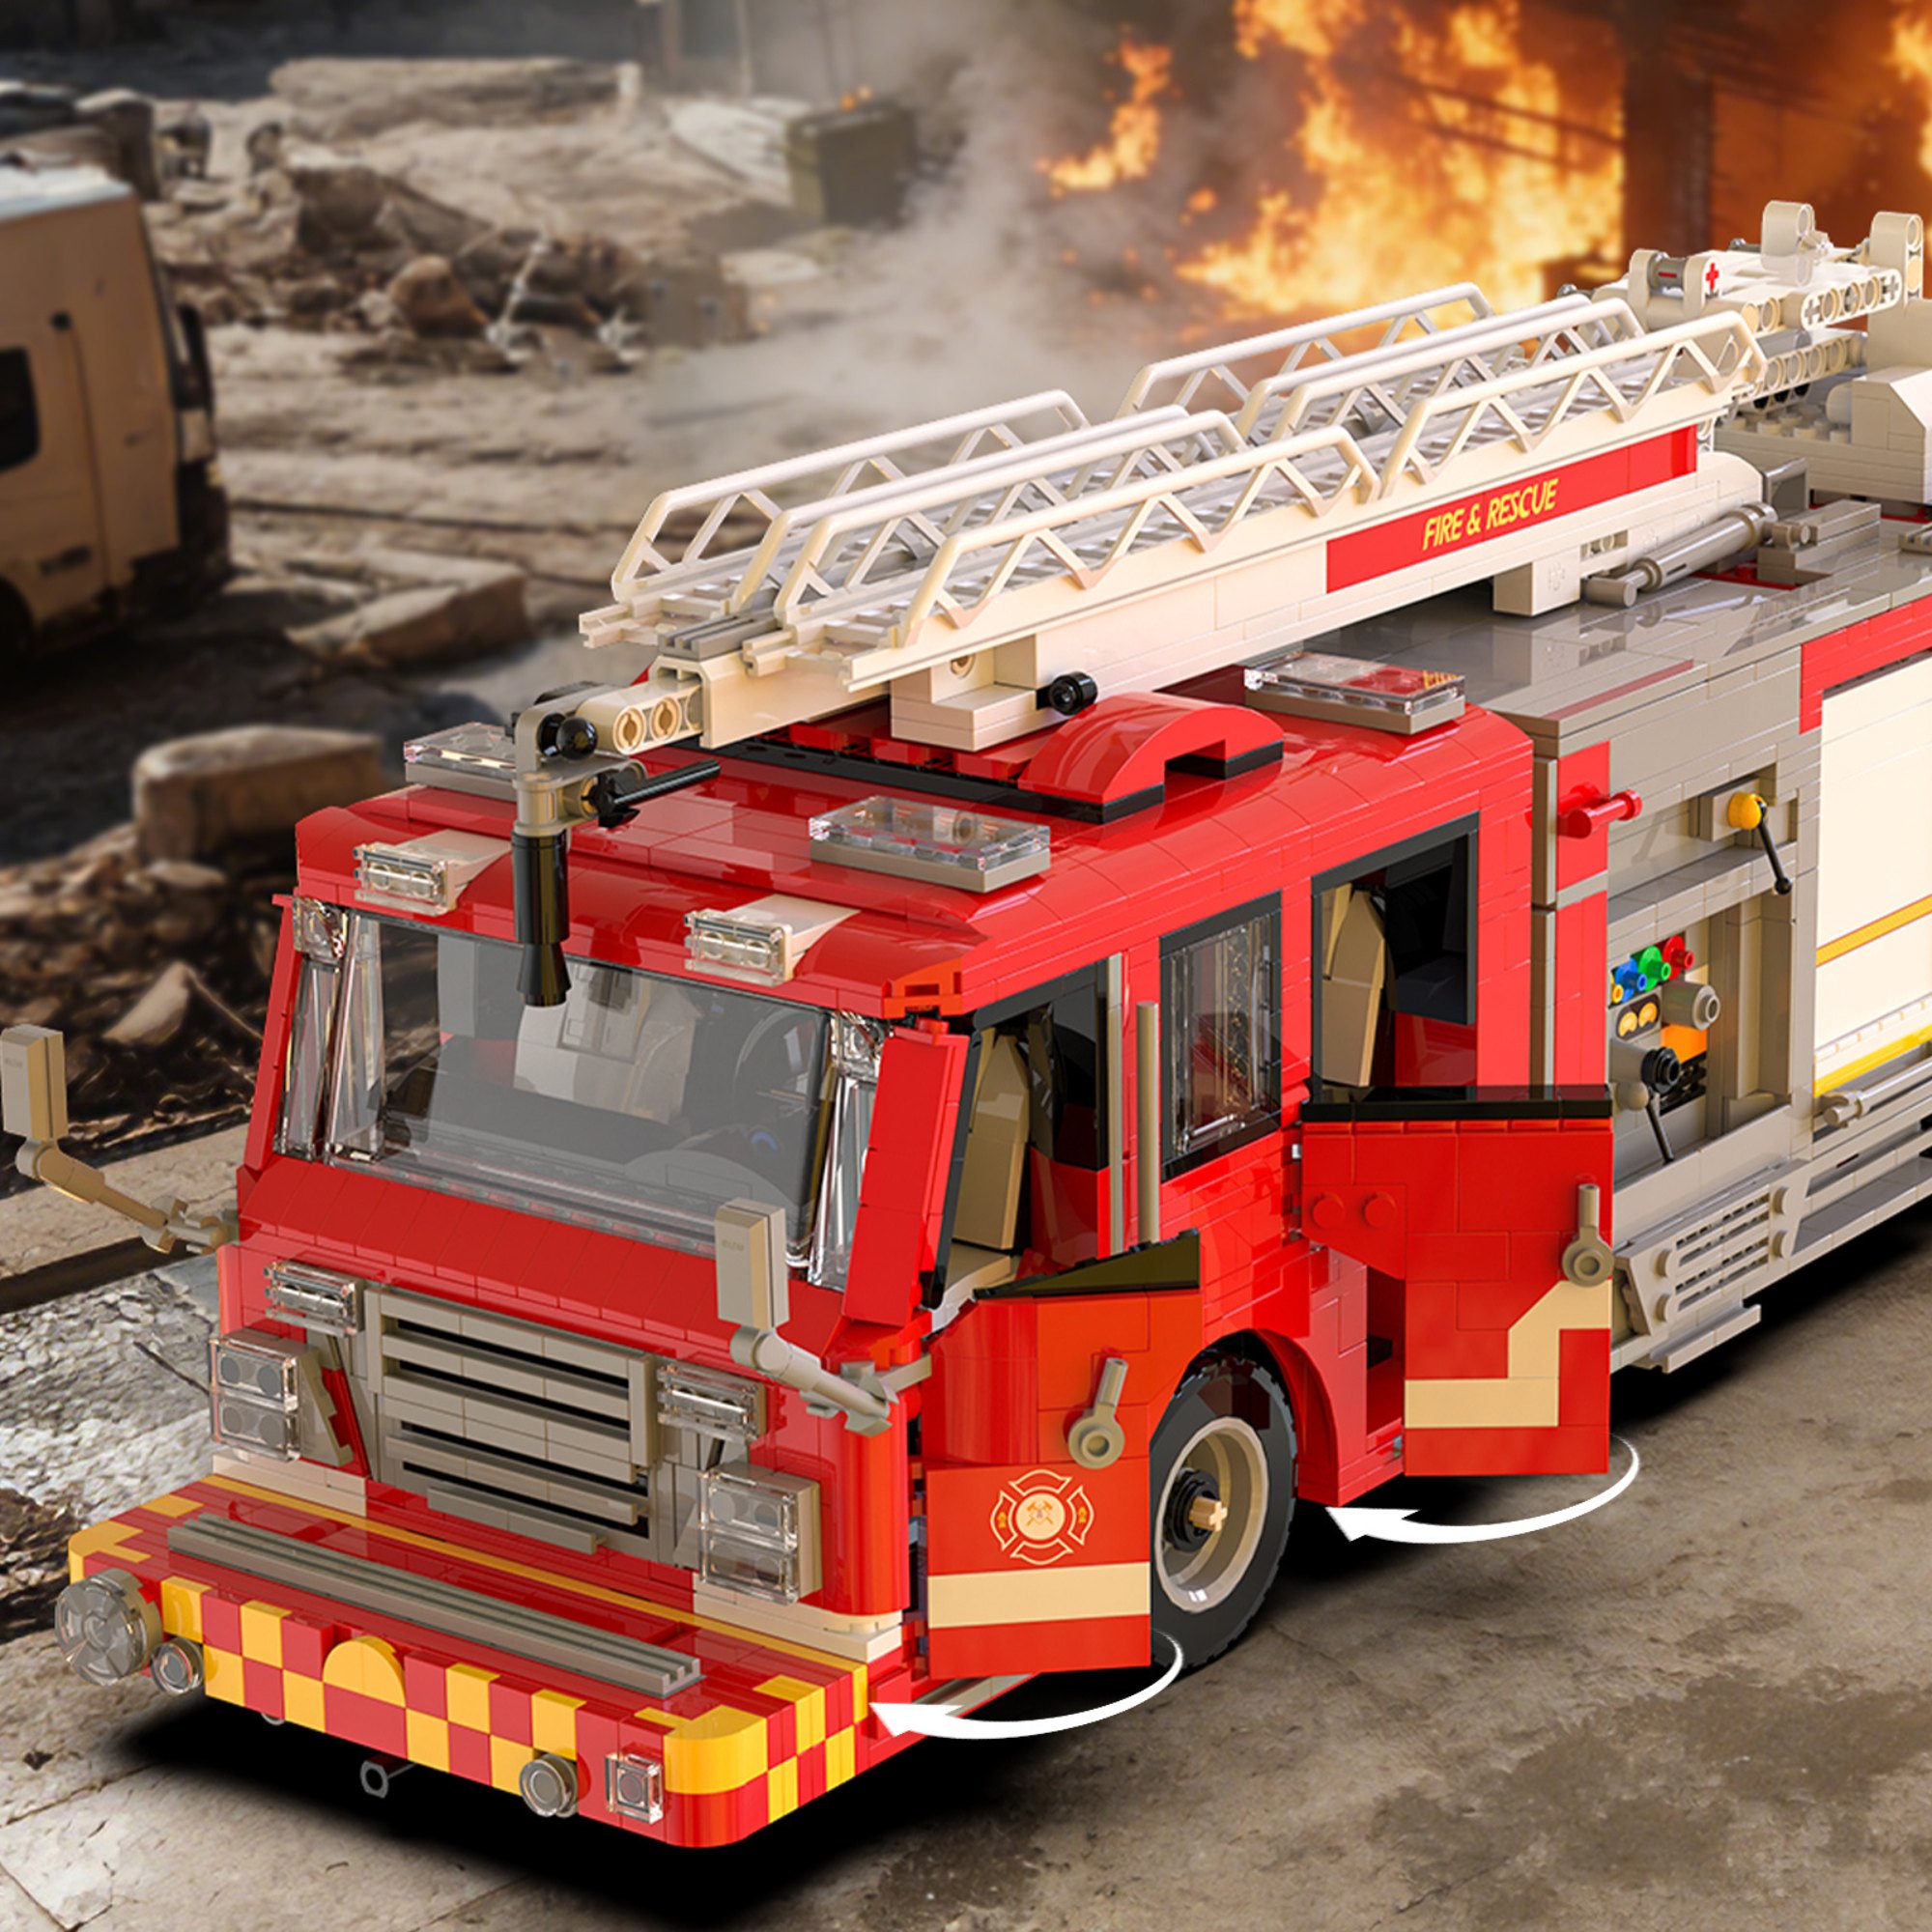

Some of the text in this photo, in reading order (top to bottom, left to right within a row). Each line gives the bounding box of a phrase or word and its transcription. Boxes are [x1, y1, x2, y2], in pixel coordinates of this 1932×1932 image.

[1422, 478, 1559, 551] FIRE & RESCUE
